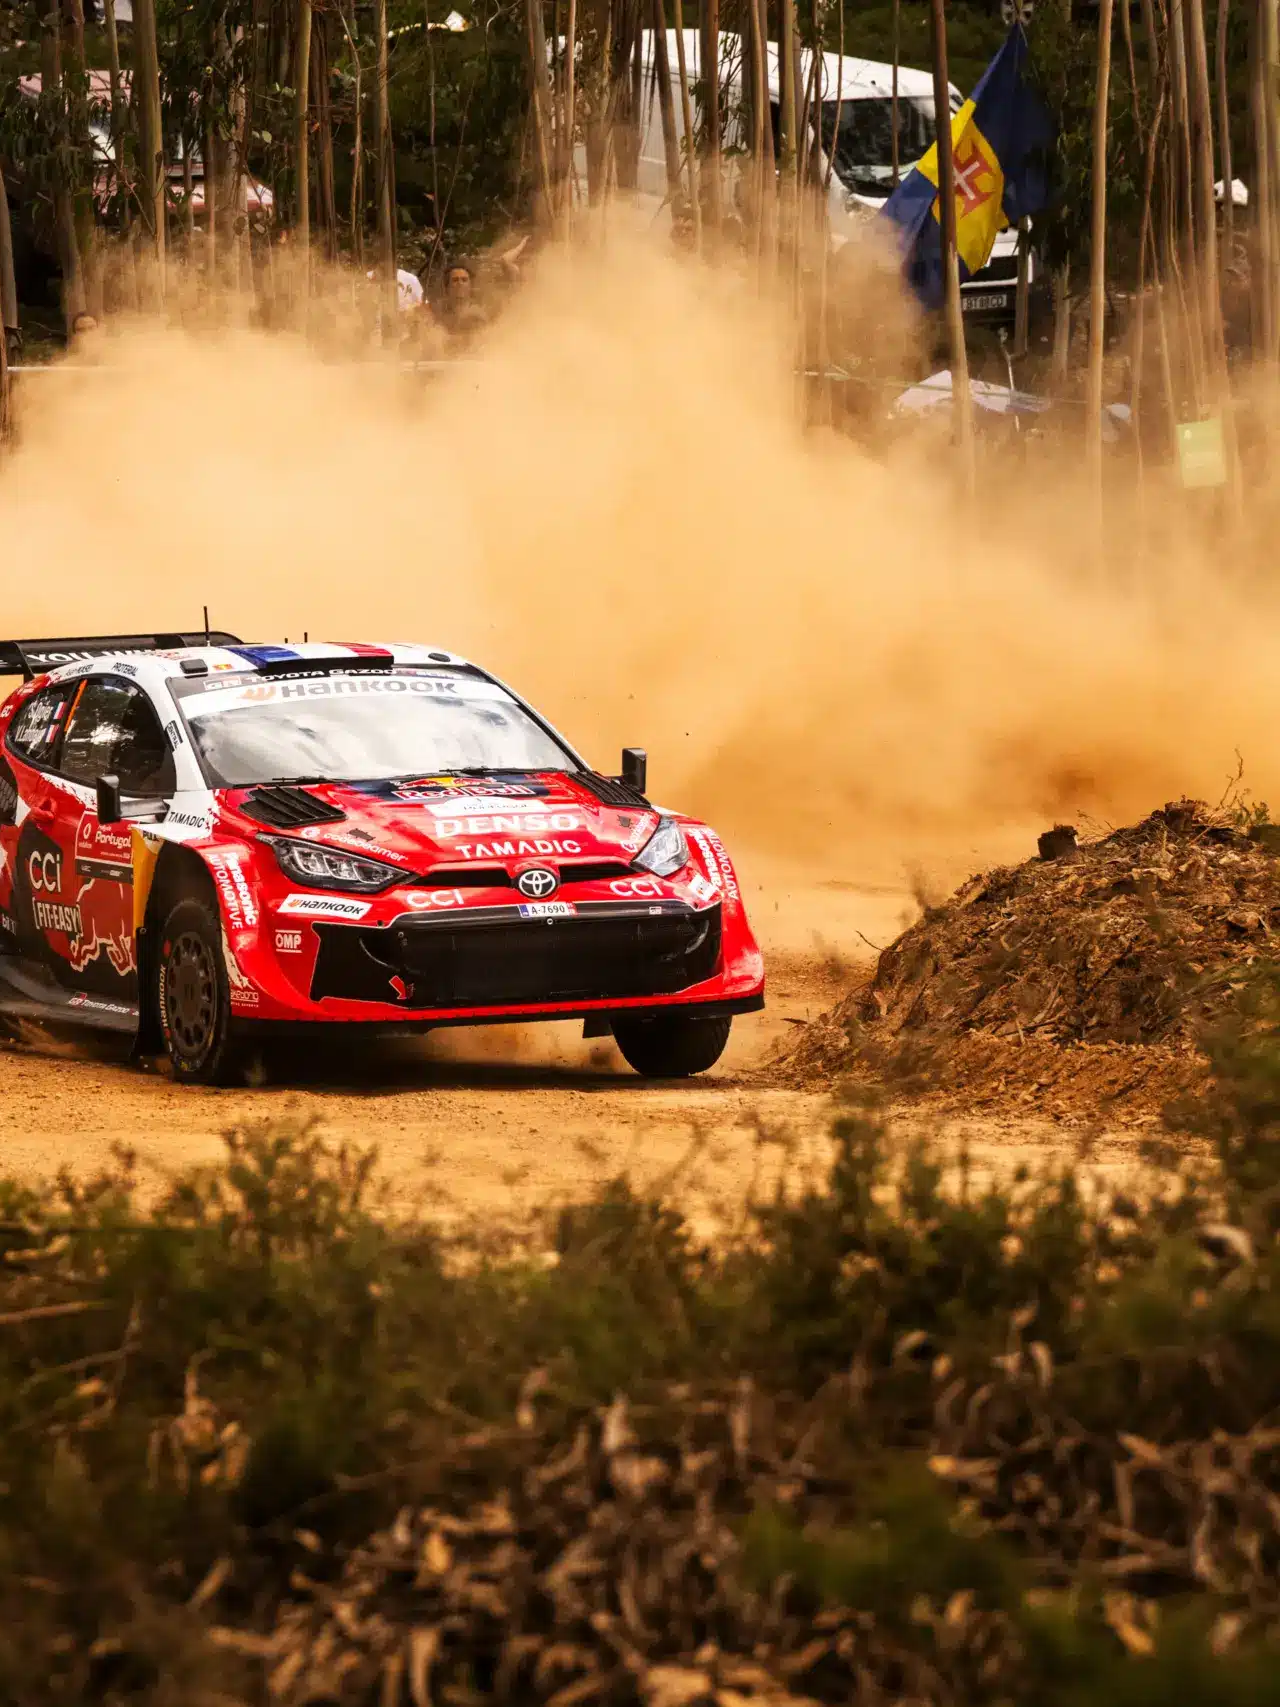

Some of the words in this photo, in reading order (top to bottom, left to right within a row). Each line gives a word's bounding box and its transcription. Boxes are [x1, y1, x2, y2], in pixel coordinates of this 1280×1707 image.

[245, 669, 325, 682] TOYOTA
[329, 668, 398, 677] GAZOO
[391, 786, 464, 800] Red
[466, 784, 536, 797] Bull
[168, 811, 205, 828] TAMADIC
[433, 814, 581, 839] DENSO
[95, 830, 132, 849] Portugal
[455, 839, 582, 859] TAMADIC
[208, 853, 243, 930] AUTOMOTIVE
[531, 904, 566, 915] A-7690
[275, 933, 302, 949] OMP
